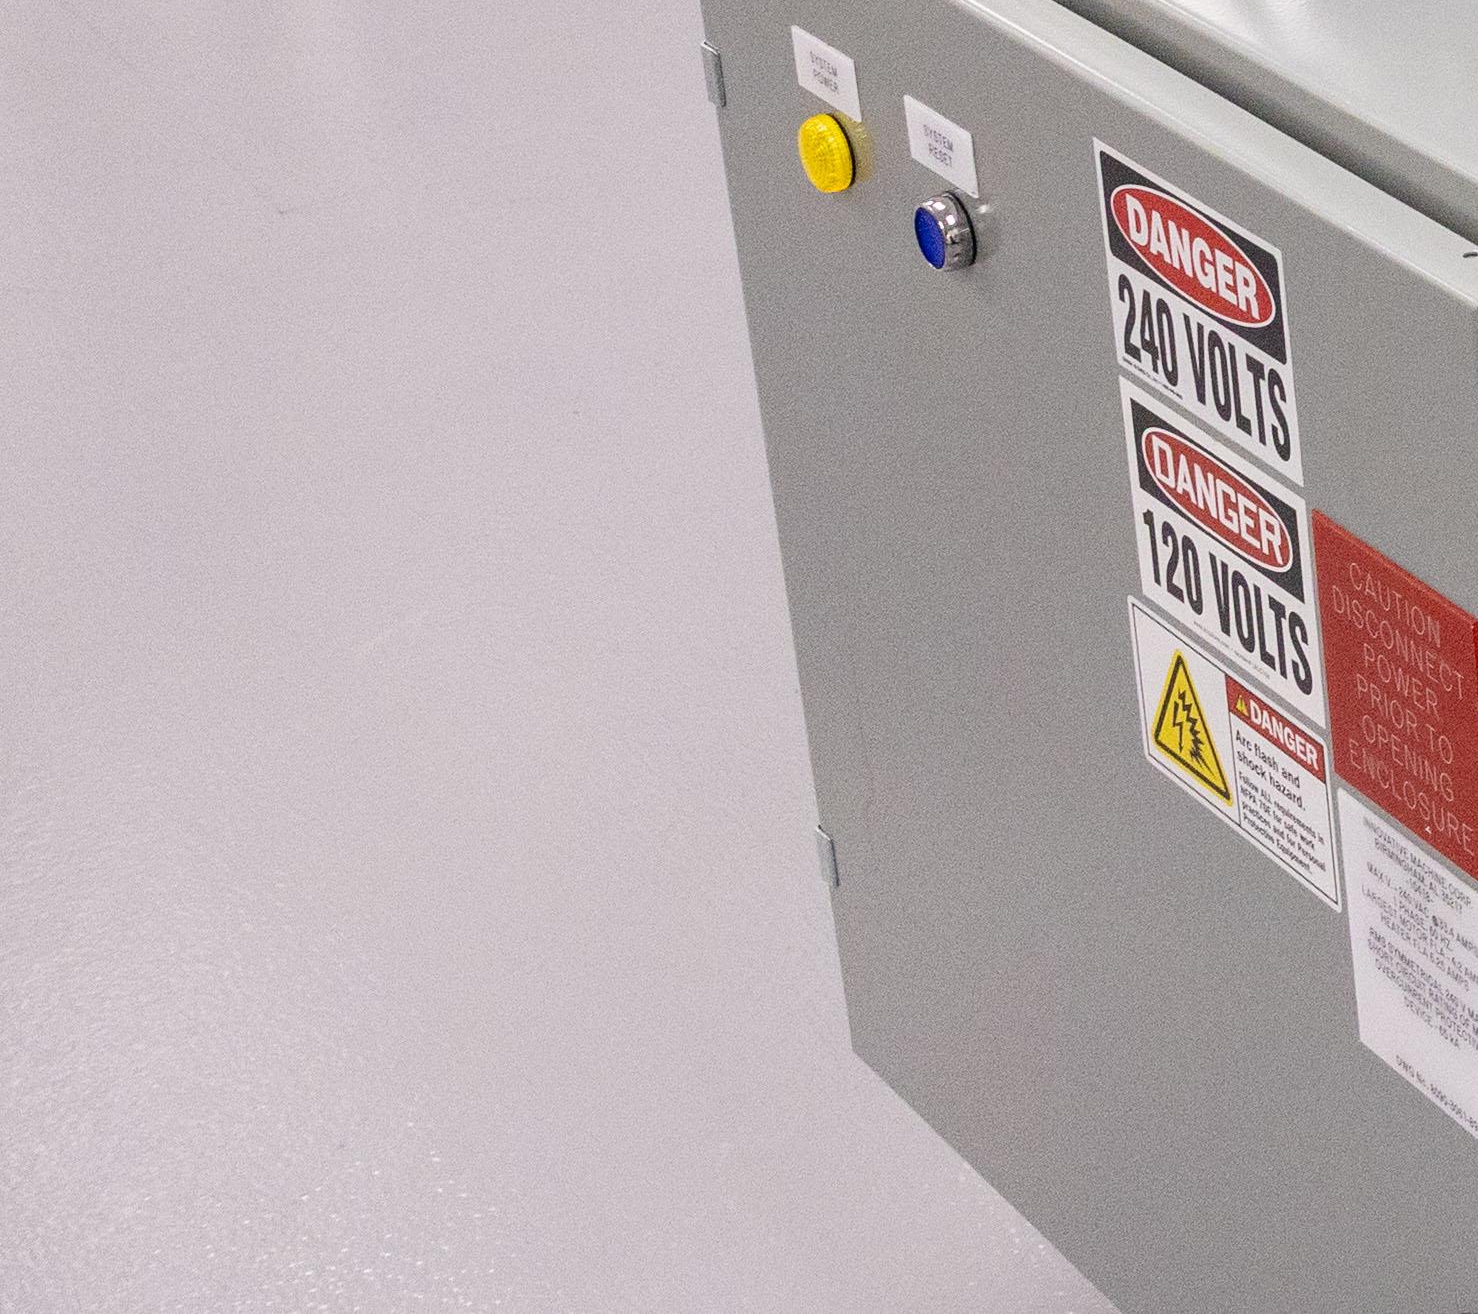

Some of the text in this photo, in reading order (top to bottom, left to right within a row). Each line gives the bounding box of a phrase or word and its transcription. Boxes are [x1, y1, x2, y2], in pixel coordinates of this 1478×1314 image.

[1125, 193, 1260, 319] DANGER
[1118, 274, 1291, 462] 240 VOLTS
[1151, 434, 1283, 565] DANGER
[1143, 509, 1203, 615] 120
[1209, 551, 1312, 695] VOLTS
[1332, 584, 1463, 699] DISCONNECT
[1349, 562, 1440, 647] CAUTION
[1357, 674, 1453, 764] PRIOR TO
[1364, 643, 1438, 721] POWER
[1236, 728, 1300, 788] Arc flash and
[1238, 747, 1306, 810] shock hazard.
[1250, 698, 1319, 771] DANGER
[1362, 714, 1453, 802] OPENING
[1348, 738, 1473, 857] ENCLOSURE
